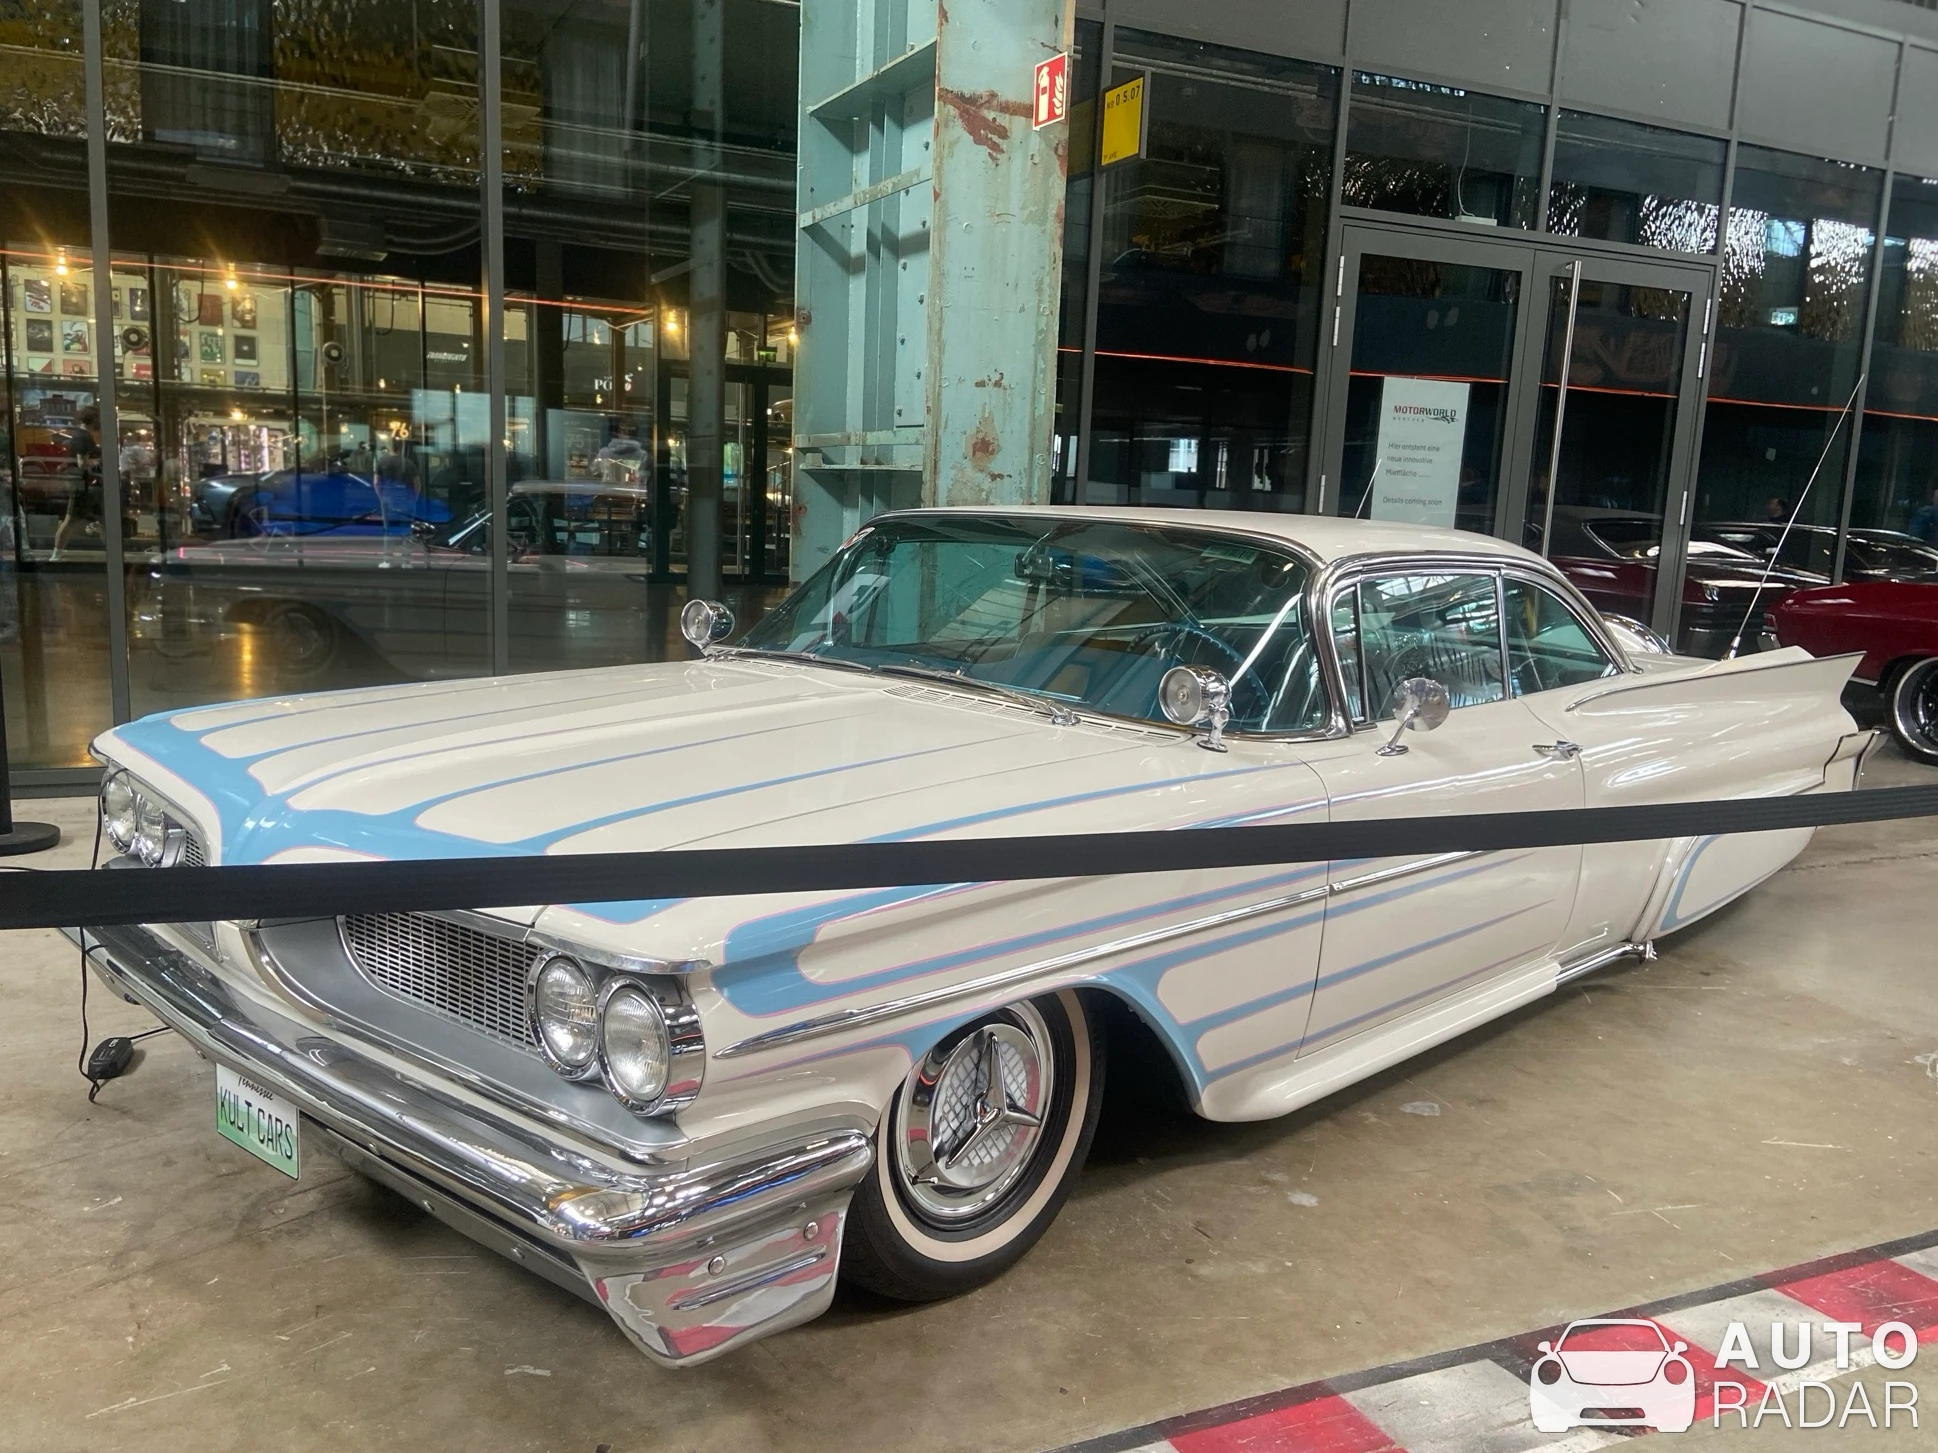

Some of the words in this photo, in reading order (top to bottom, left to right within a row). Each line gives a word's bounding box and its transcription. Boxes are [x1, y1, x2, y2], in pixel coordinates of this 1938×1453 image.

[1393, 405, 1457, 418] MOTORWORLD
[1388, 442, 1401, 450] Hier
[1383, 496, 1404, 504] Details
[1404, 498, 1427, 506] coming
[220, 1086, 252, 1137] KULT
[257, 1107, 293, 1160] CARS
